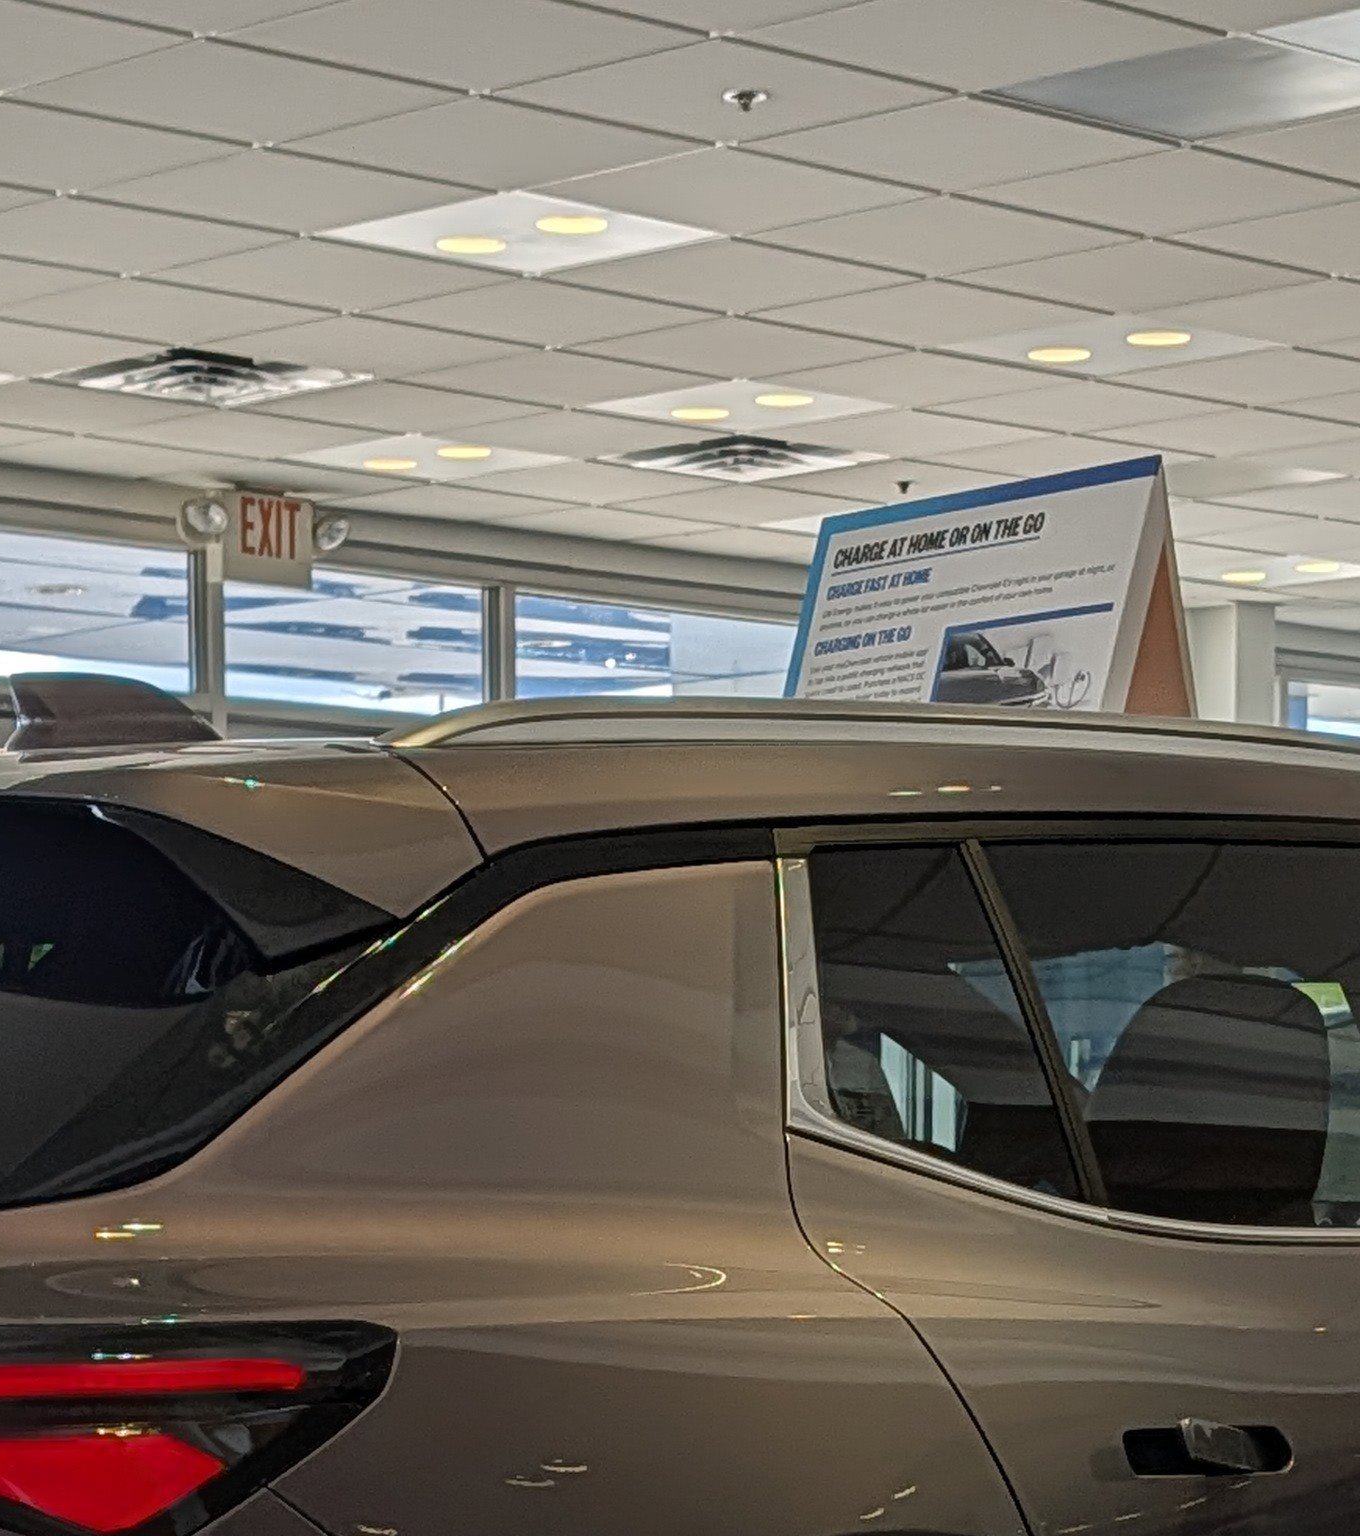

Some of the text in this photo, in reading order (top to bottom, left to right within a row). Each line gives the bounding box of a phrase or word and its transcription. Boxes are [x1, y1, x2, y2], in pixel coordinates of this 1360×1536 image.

[240, 496, 301, 560] EXIT
[833, 511, 1045, 569] CHARGE AT HOME OR ON THE GO
[826, 567, 933, 602] CHARGE FAST AT HOME
[971, 580, 1001, 593] Chevrolet
[814, 625, 913, 657] CHARGING ON THE GO
